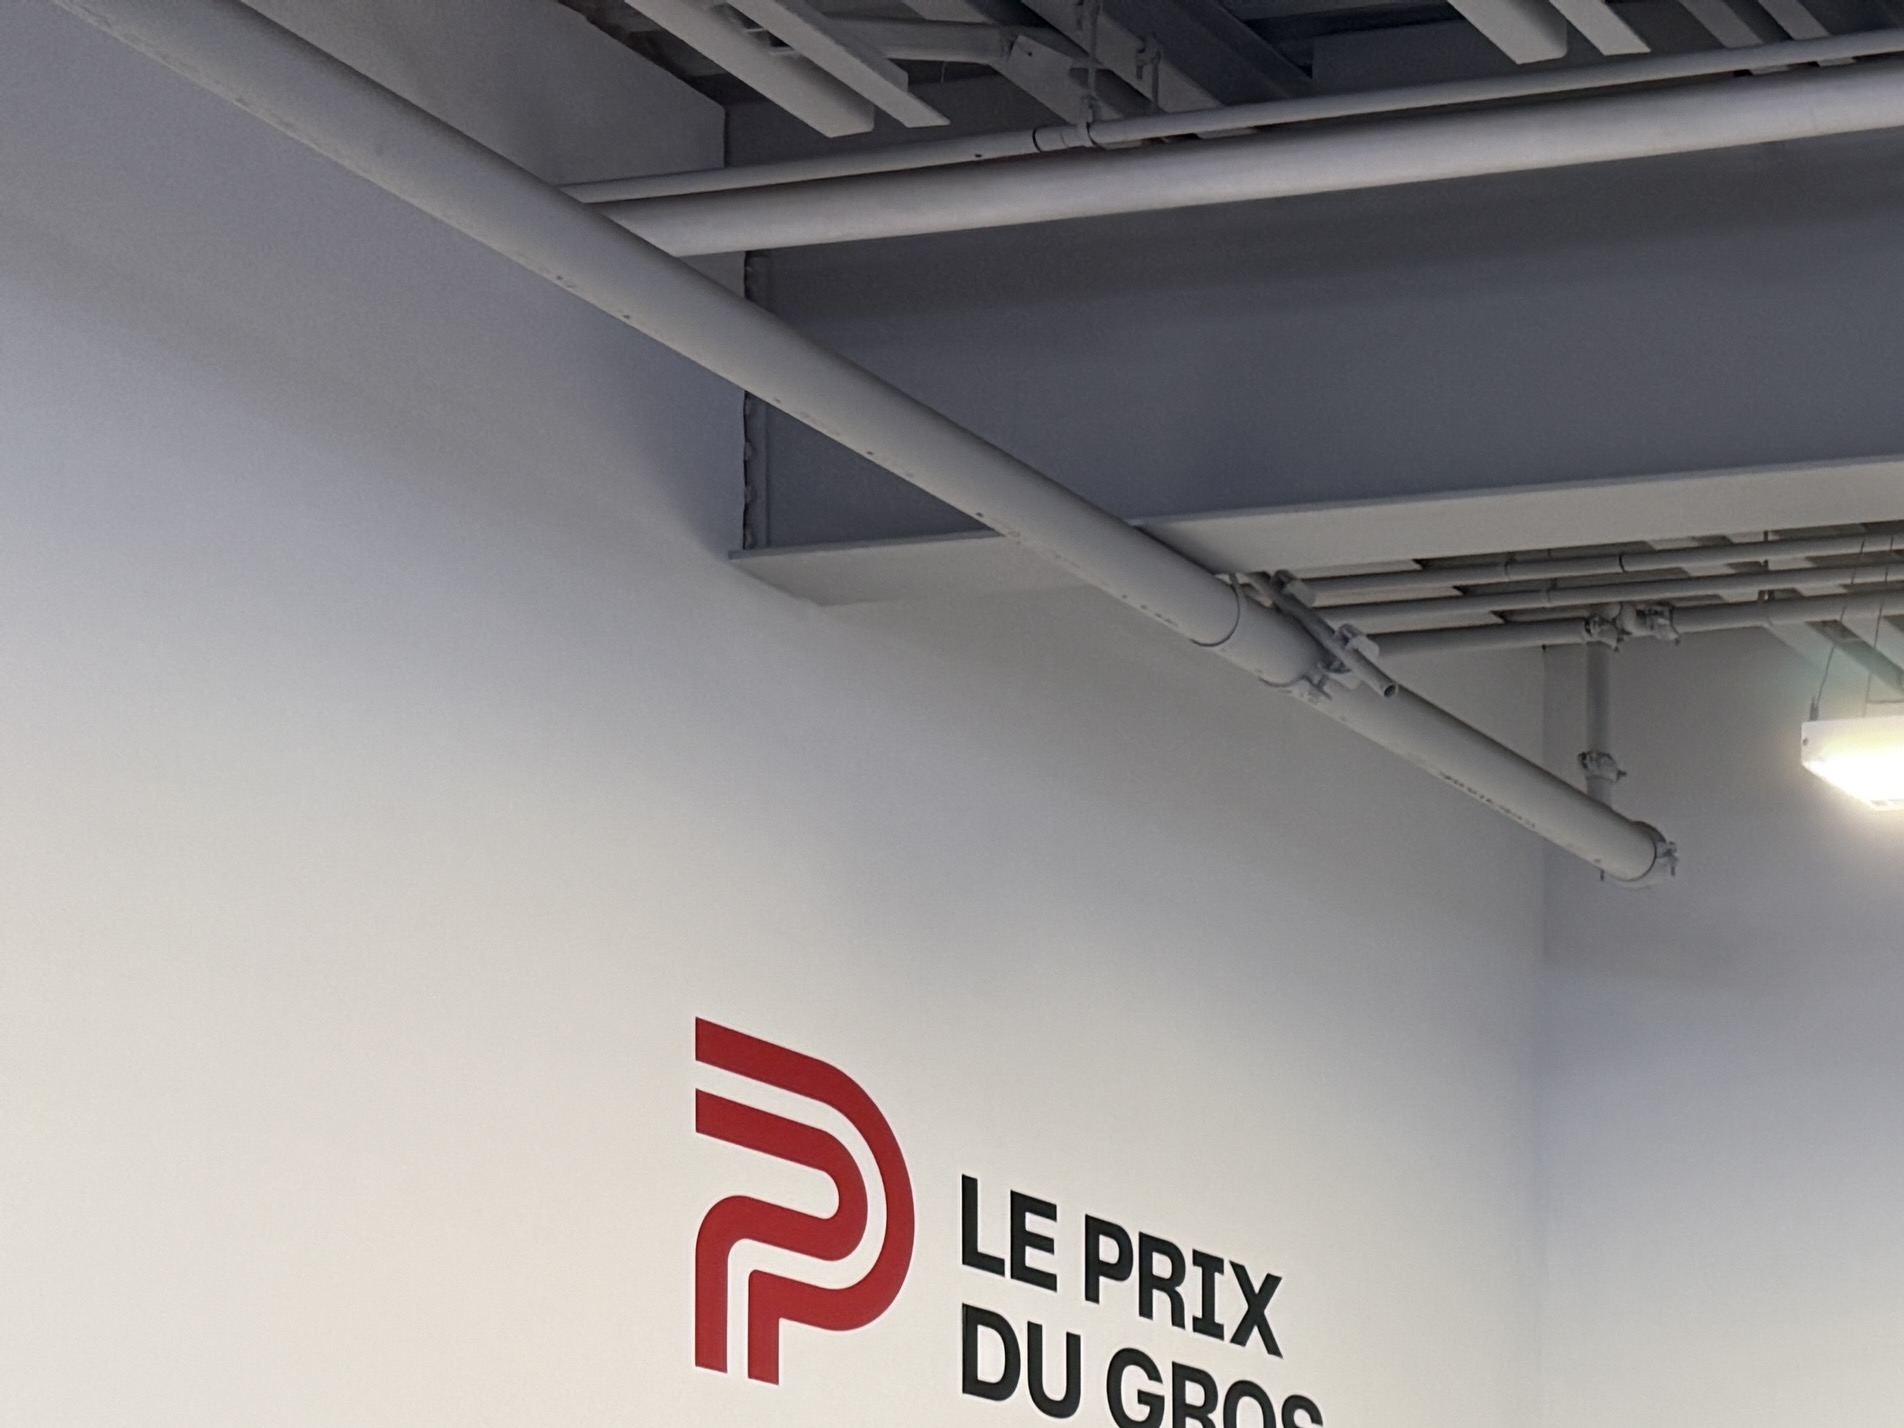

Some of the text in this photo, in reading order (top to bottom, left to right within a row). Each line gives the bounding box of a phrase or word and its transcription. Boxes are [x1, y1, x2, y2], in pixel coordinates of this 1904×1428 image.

[961, 1173, 1283, 1359] LE PRIX
[961, 1302, 1081, 1419] DU
